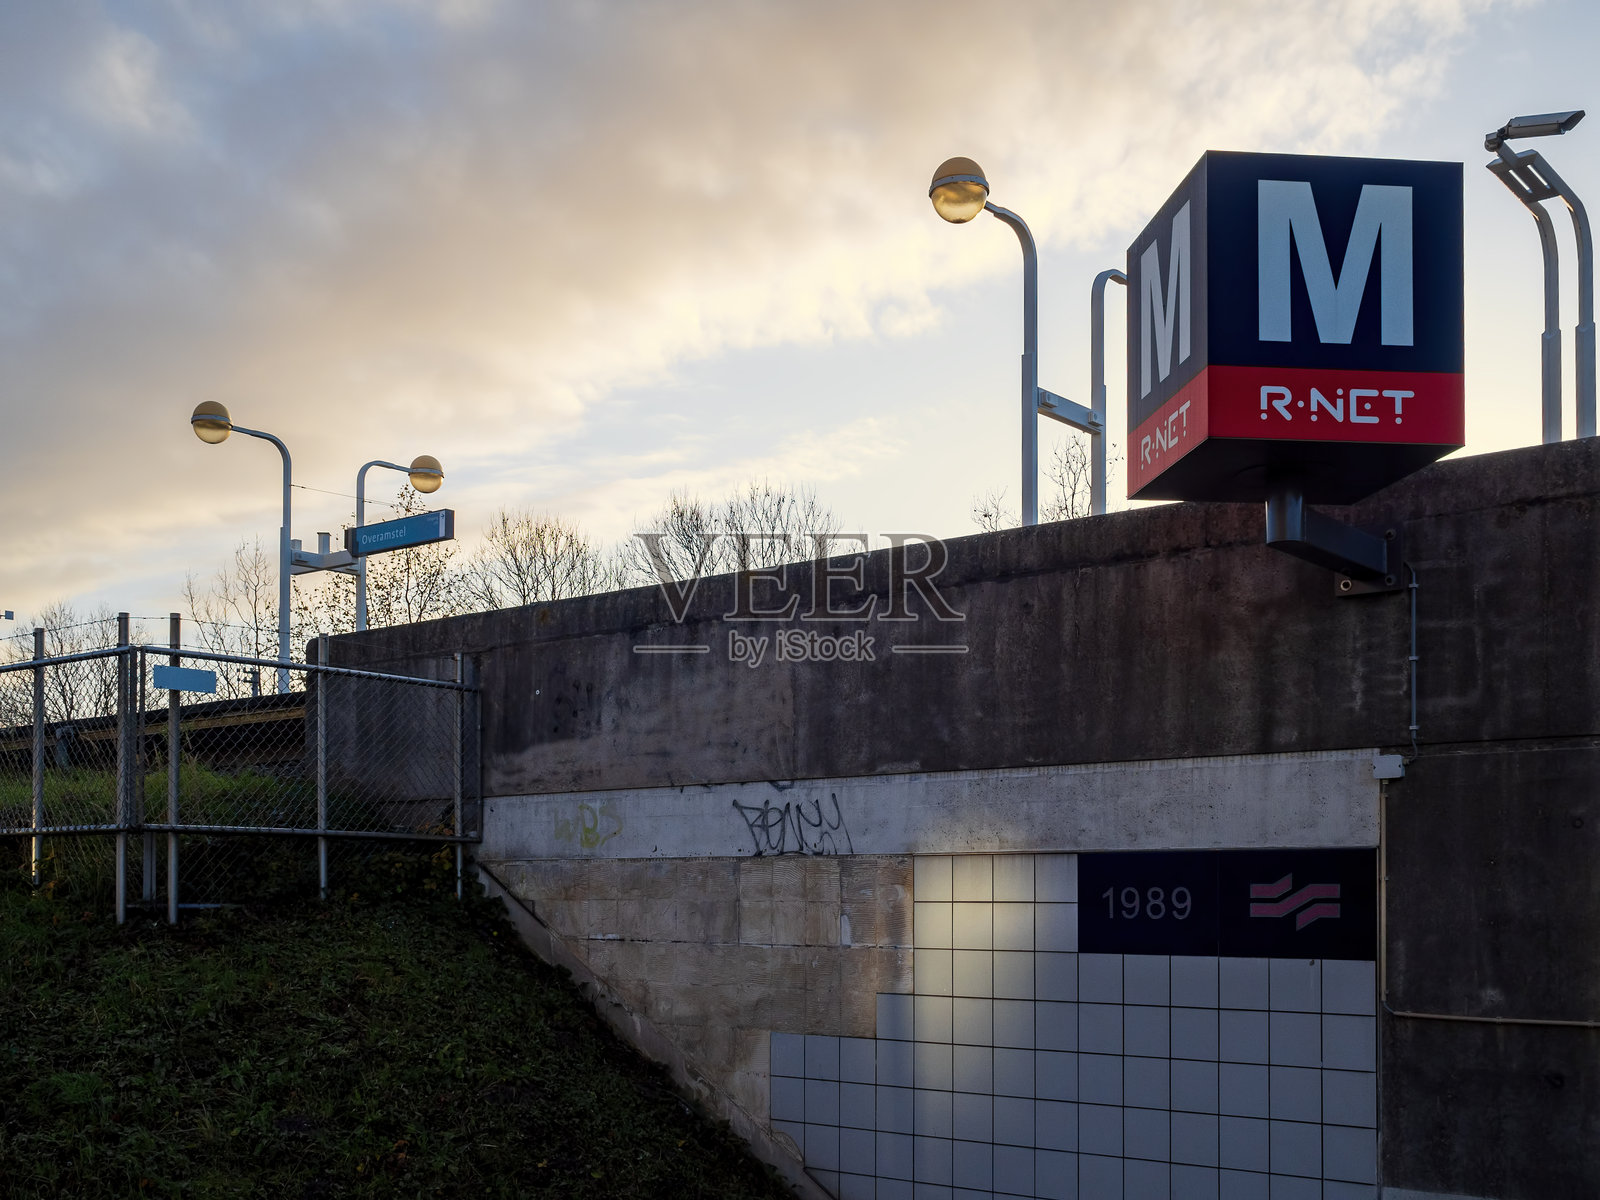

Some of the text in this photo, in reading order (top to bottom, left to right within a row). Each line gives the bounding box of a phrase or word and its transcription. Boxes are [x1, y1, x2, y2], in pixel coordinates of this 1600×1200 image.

[1141, 199, 1191, 400] M
[1258, 179, 1414, 347] M
[361, 525, 407, 545] Overamstel
[1102, 886, 1192, 920] 1989
